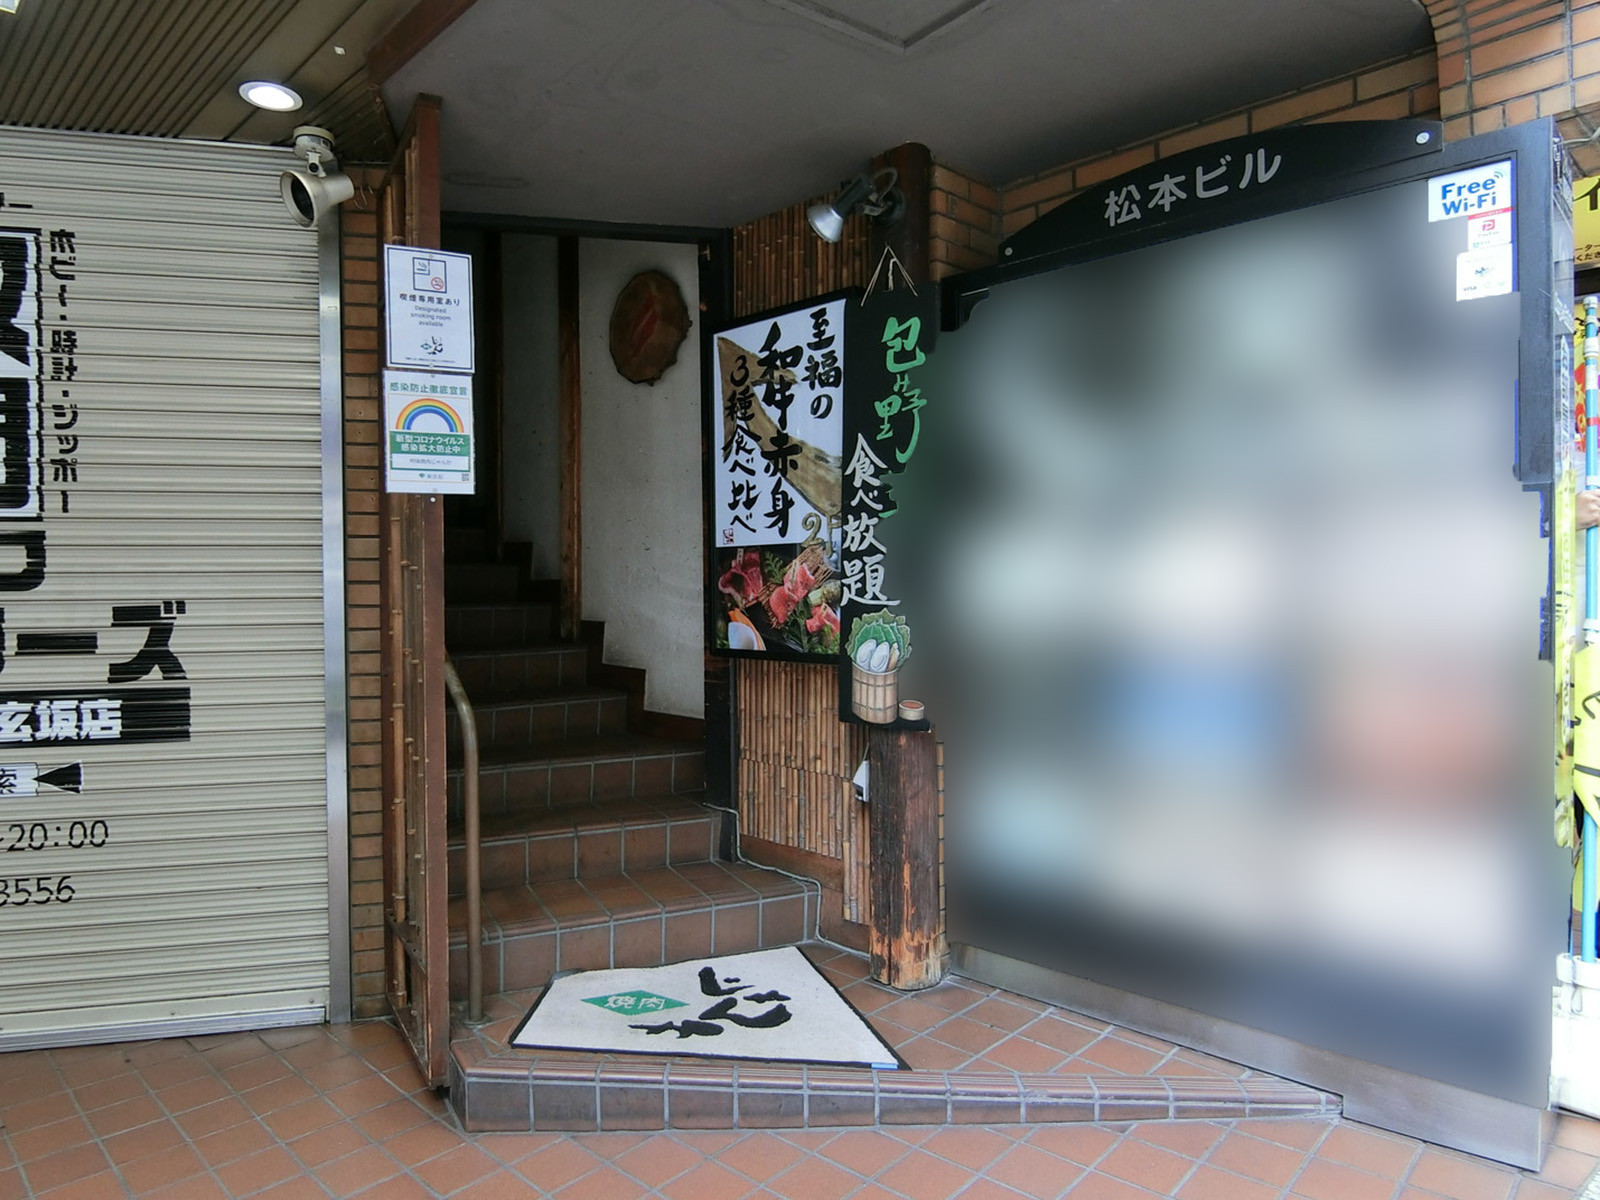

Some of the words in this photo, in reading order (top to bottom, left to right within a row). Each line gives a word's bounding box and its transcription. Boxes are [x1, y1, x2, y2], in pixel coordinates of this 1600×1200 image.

[1104, 148, 1282, 227] 松本ビル
[1441, 178, 1496, 200] Free
[1442, 192, 1497, 216] Wi-Fi
[399, 293, 460, 306] 喫煙専用室あり
[415, 305, 447, 313] Designated
[410, 312, 434, 321] smoking
[801, 307, 841, 419] 至福の
[390, 382, 468, 396] 感染防止徹底宣言
[395, 435, 465, 445] 新型コロナウイルス
[757, 321, 803, 538] 和牛赤身
[401, 443, 460, 454] 感染拡大防止中
[722, 354, 762, 533] 3種食べ比べ
[841, 432, 900, 606] 食べ放題
[0, 600, 190, 683] ーズ
[604, 996, 666, 1009] 焼肉
